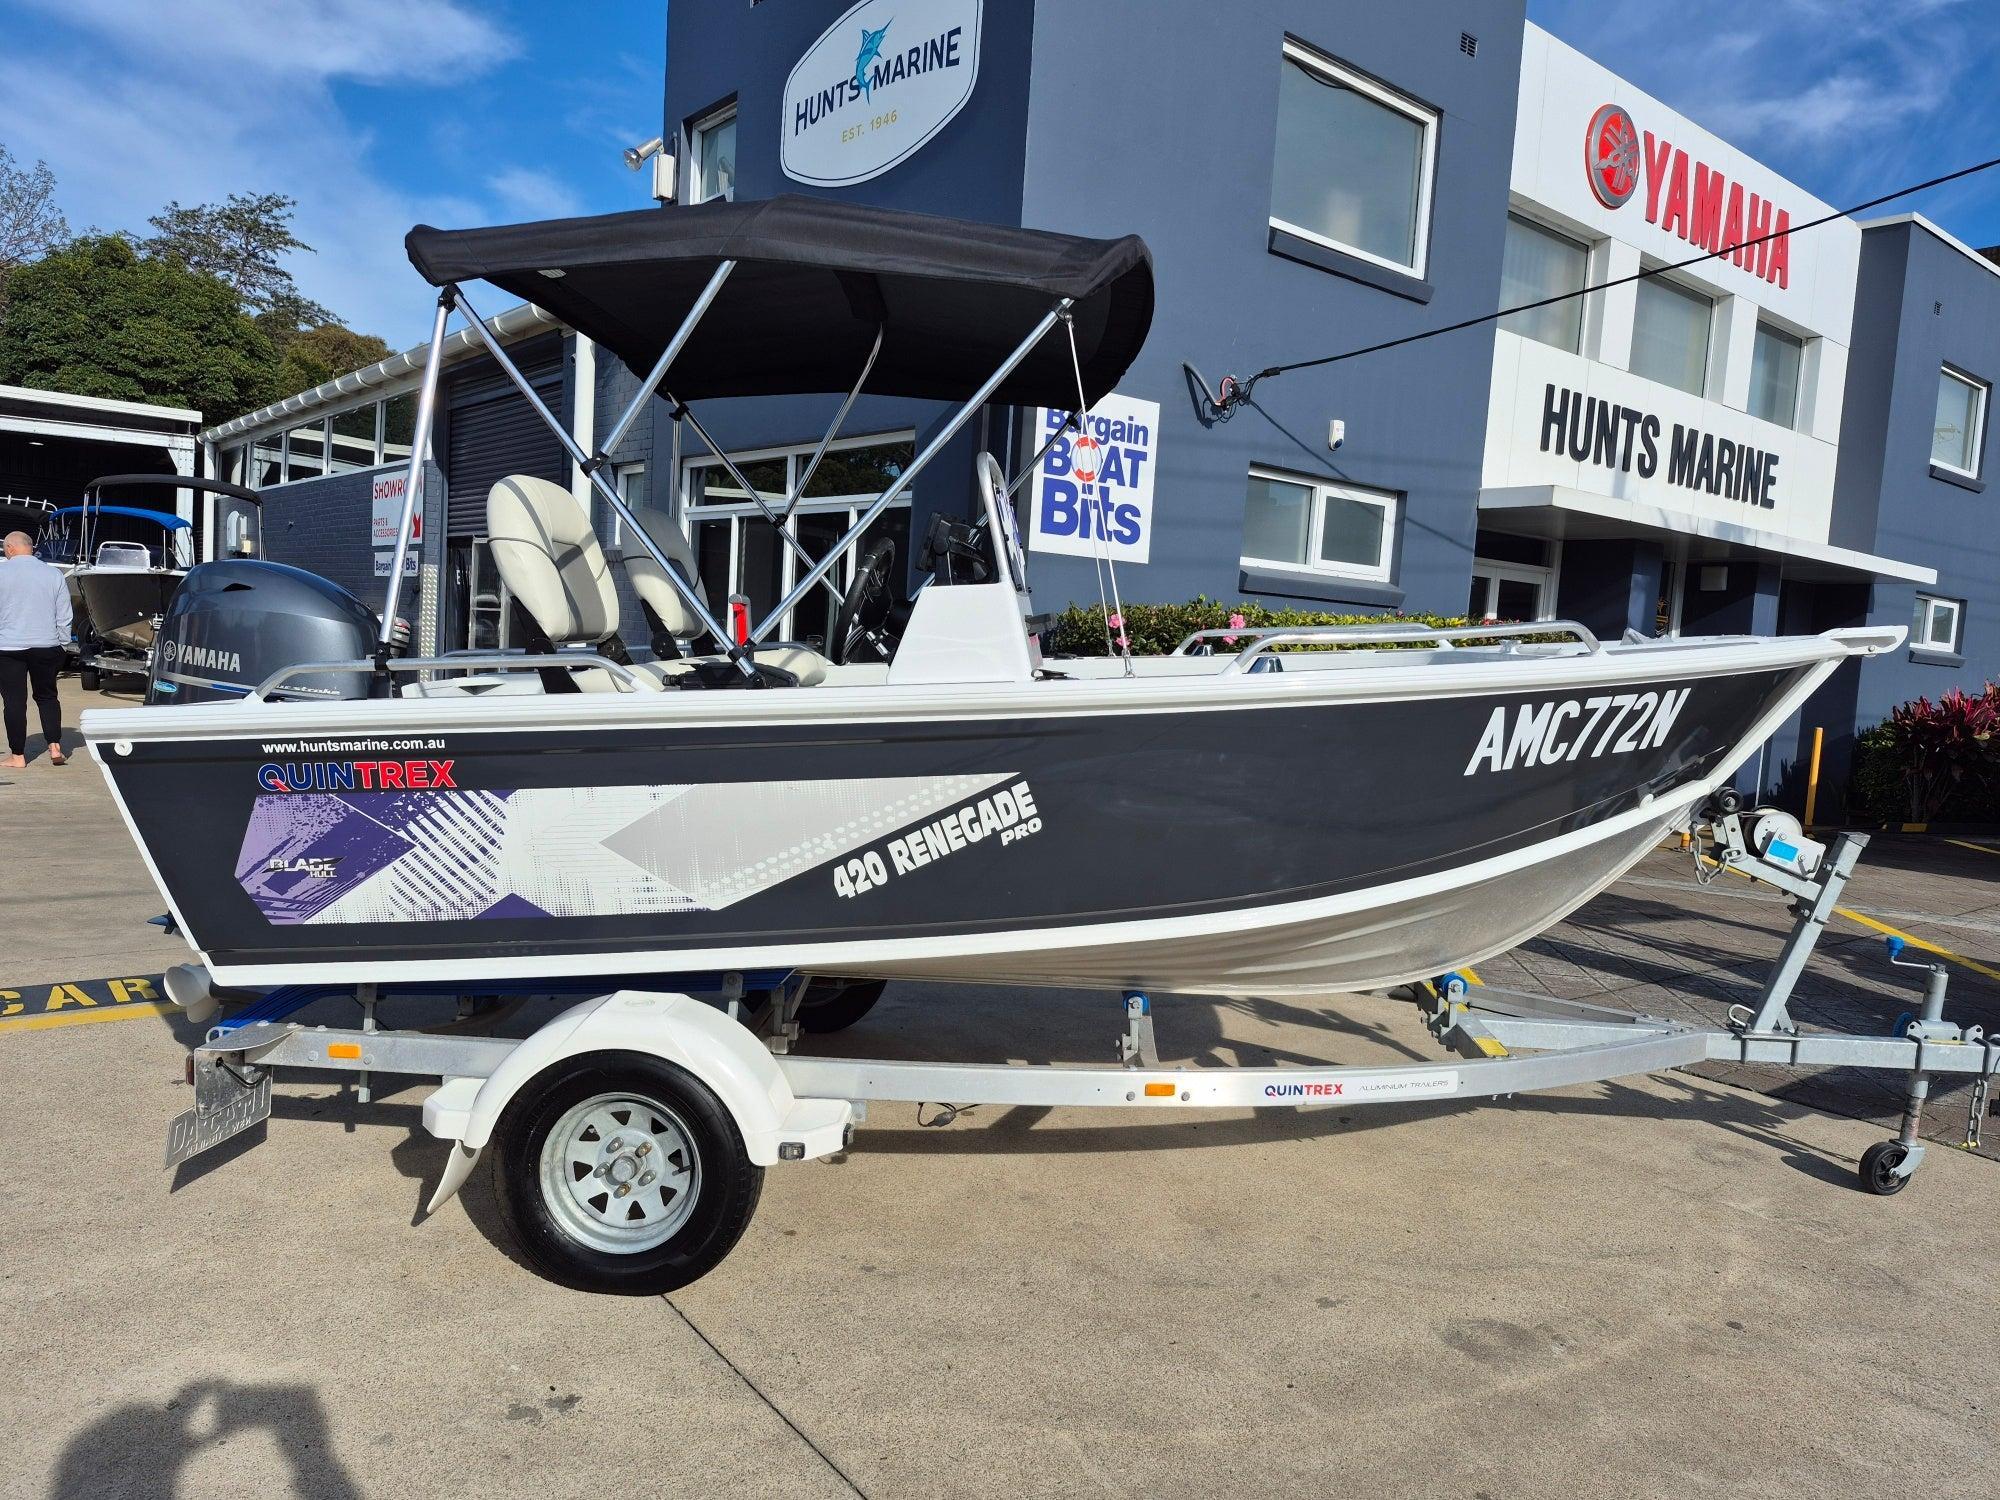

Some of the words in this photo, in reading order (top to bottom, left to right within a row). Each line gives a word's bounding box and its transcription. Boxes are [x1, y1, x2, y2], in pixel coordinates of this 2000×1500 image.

[794, 75, 862, 137] HUNTS
[872, 26, 962, 91] MARINE
[841, 125, 865, 143] EST.
[870, 109, 898, 131] 1946
[1643, 130, 1791, 290] YAMAHA
[1540, 383, 1661, 479] HUNTS
[1667, 423, 1780, 510] MARINE
[1040, 476, 1142, 545] Bits
[406, 557, 417, 571] Bits
[177, 643, 241, 673] YAMAHA
[262, 738, 446, 754] www.huntsmarine.com.au
[1463, 688, 1692, 776] AMC772N
[257, 760, 458, 792] QUINTREX
[833, 850, 888, 899] 420
[887, 780, 1038, 876] RENEGADE
[1000, 817, 1043, 847] PRO
[268, 857, 337, 872] BLADE
[310, 870, 338, 878] HULL
[1264, 1084, 1344, 1097] QUINTREX
[1359, 1082, 1408, 1092] ALUMINIUM
[1410, 1079, 1449, 1088] TRAILERS
